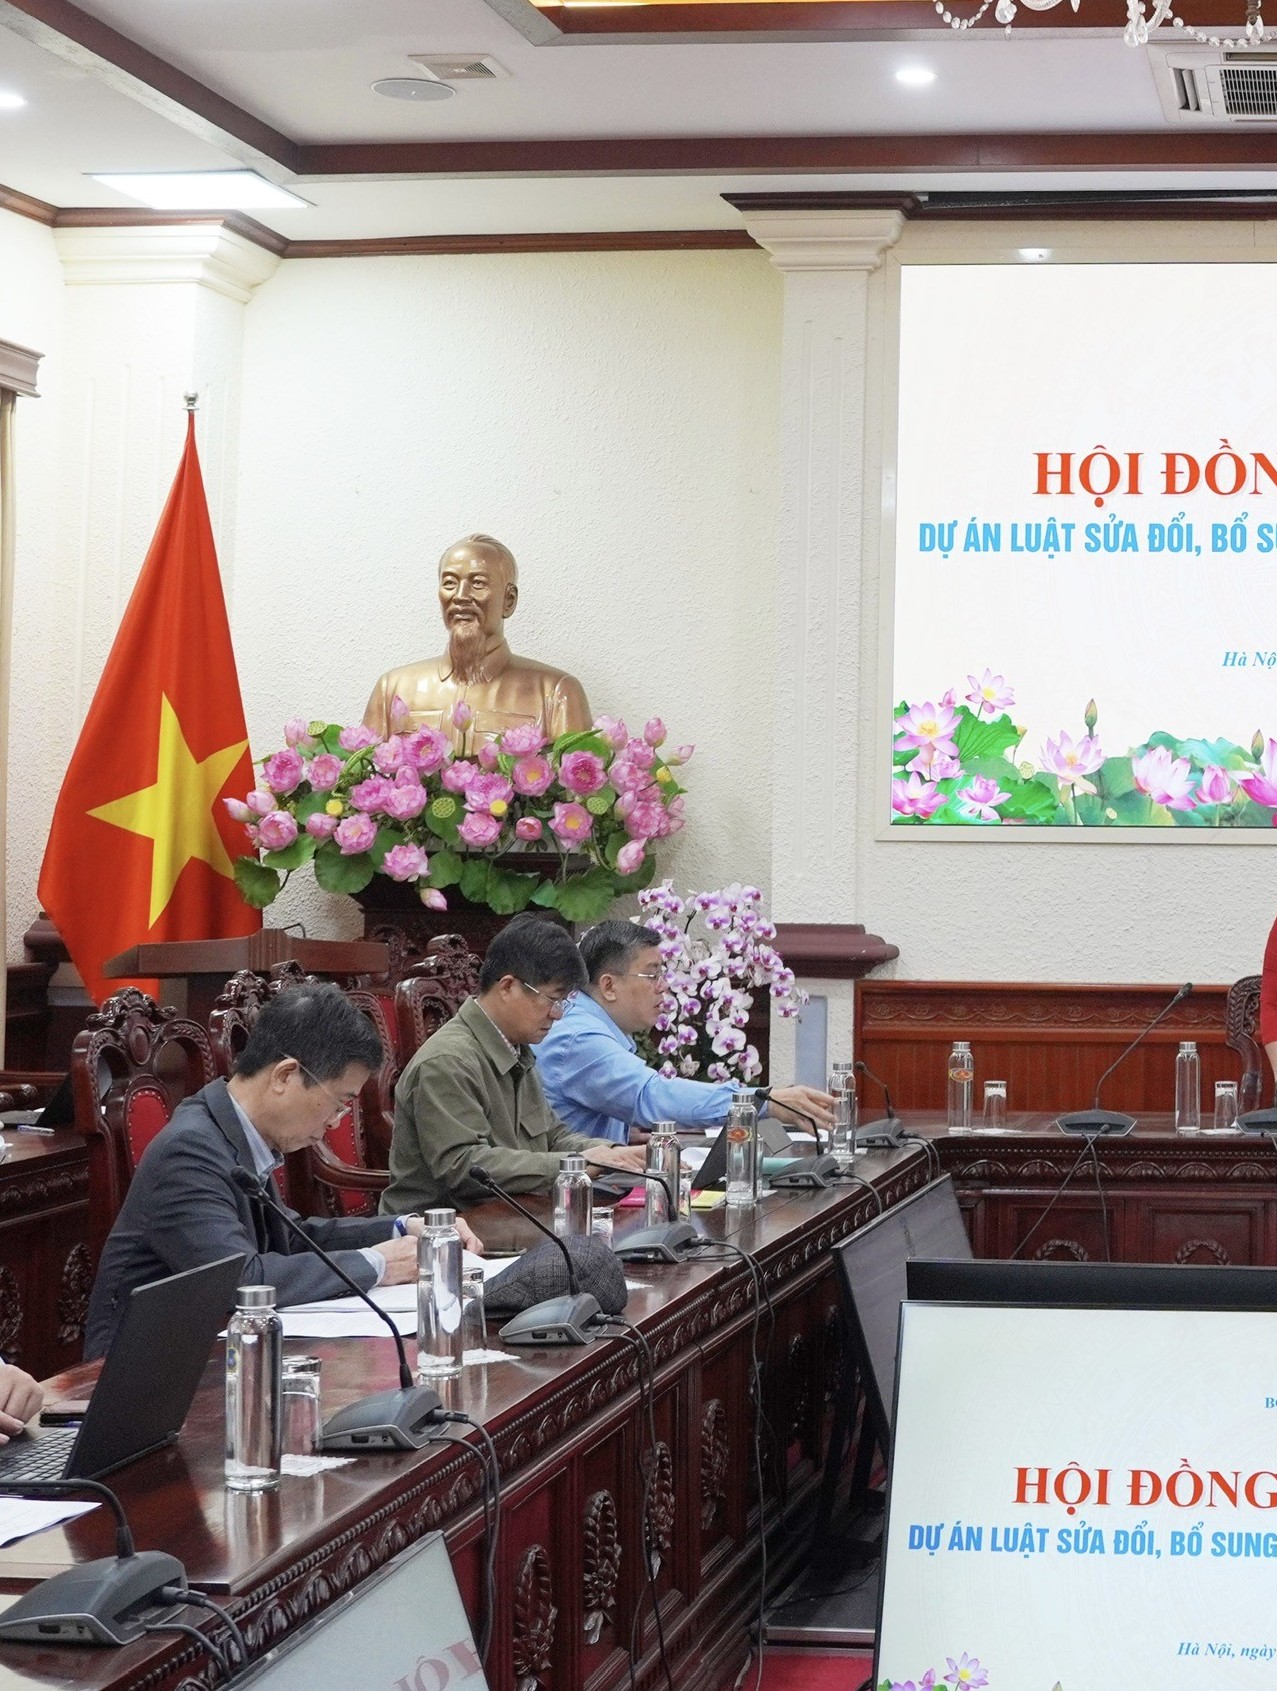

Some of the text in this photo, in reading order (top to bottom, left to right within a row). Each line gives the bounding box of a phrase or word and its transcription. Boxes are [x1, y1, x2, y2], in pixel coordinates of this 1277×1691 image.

[1033, 444, 1143, 508] HỘI
[920, 519, 958, 558] DỰ
[963, 516, 1001, 552] ÁN
[1011, 517, 1075, 559] LUẬT
[1085, 513, 1139, 553] SỬA
[1148, 512, 1201, 556] ĐỔI,
[1212, 512, 1248, 553] BỔ
[1222, 651, 1246, 666] Hà
[1014, 1462, 1110, 1515] HỘI
[909, 1523, 944, 1556] DỰ
[948, 1521, 982, 1552] ÁN
[991, 1523, 1049, 1558] LUẬT
[1057, 1521, 1105, 1554] SỬA
[1114, 1520, 1161, 1559] ĐỔI,
[1171, 1521, 1204, 1556] BỔ
[1211, 1532, 1277, 1557] SUNG
[1177, 1642, 1200, 1656] Hà
[1205, 1643, 1235, 1659] Nội,
[1240, 1644, 1276, 1661] ngày
